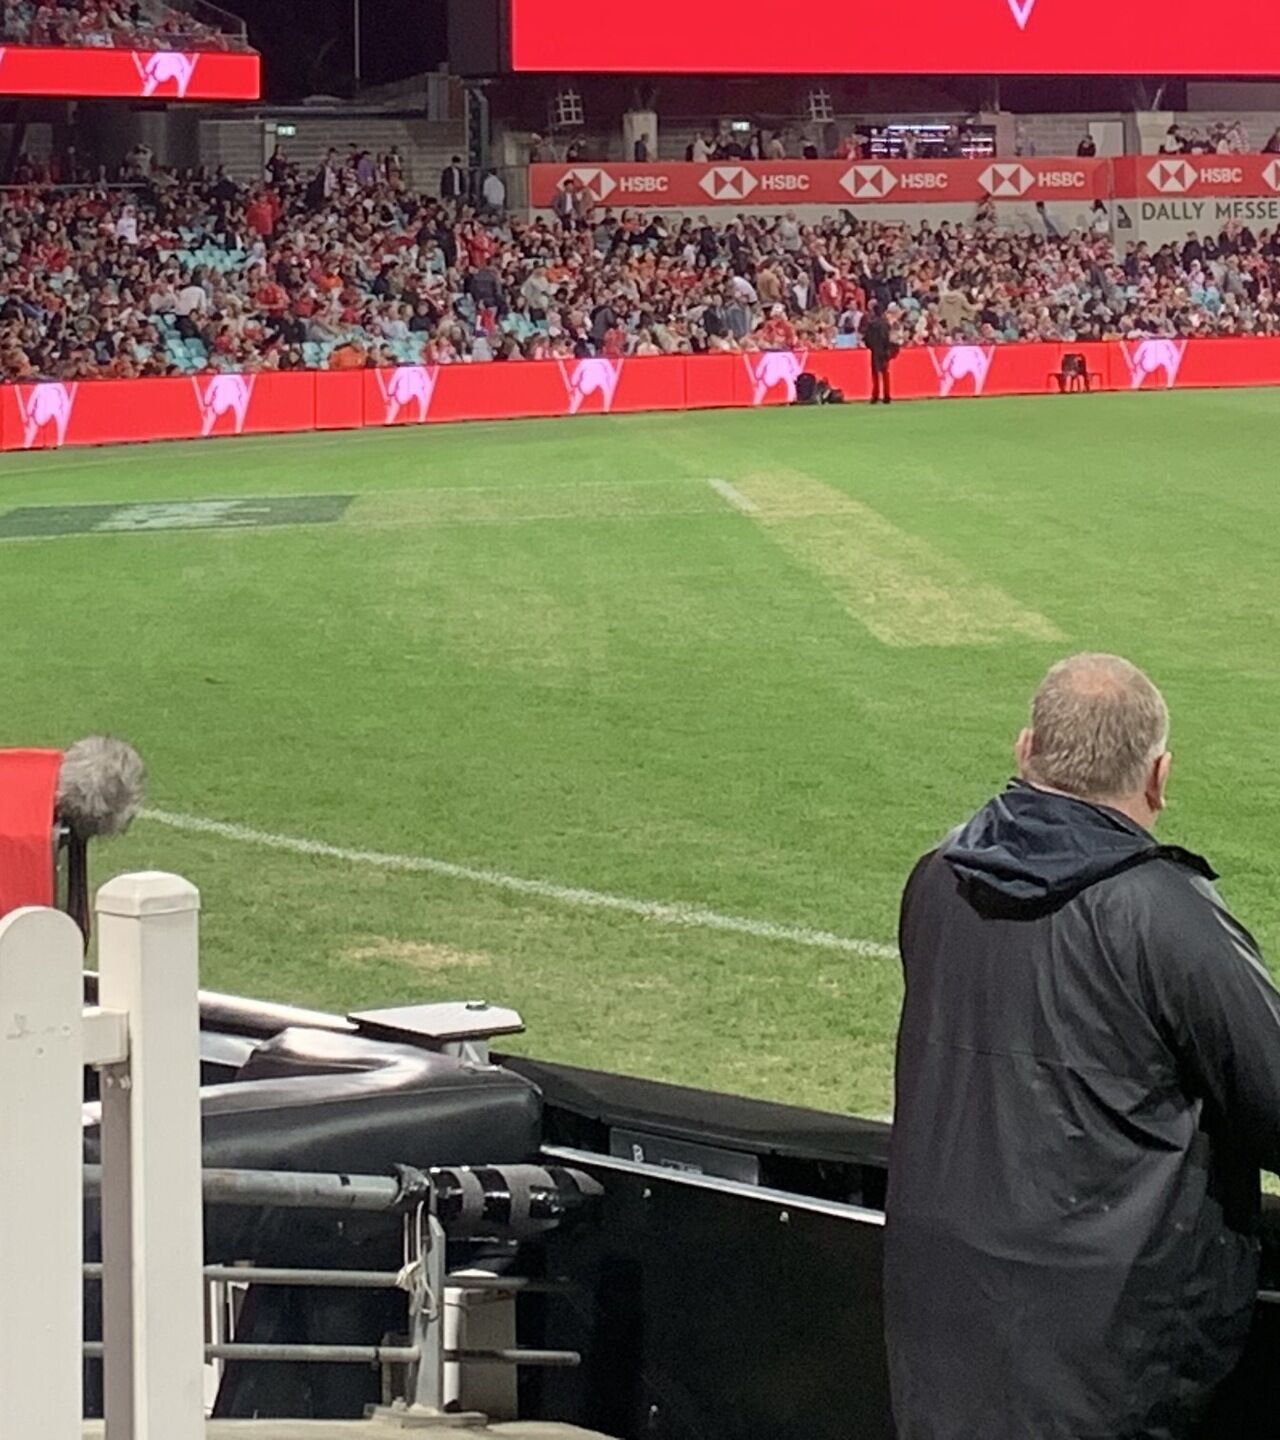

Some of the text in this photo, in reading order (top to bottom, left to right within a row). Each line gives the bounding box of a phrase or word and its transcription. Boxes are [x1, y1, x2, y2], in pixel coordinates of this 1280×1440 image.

[761, 174, 810, 190] HSBC
[901, 173, 948, 188] HSBC
[1038, 171, 1085, 187] HSBC
[1200, 167, 1243, 183] HSBC
[620, 176, 669, 192] HSBC
[1142, 201, 1206, 221] DALLY
